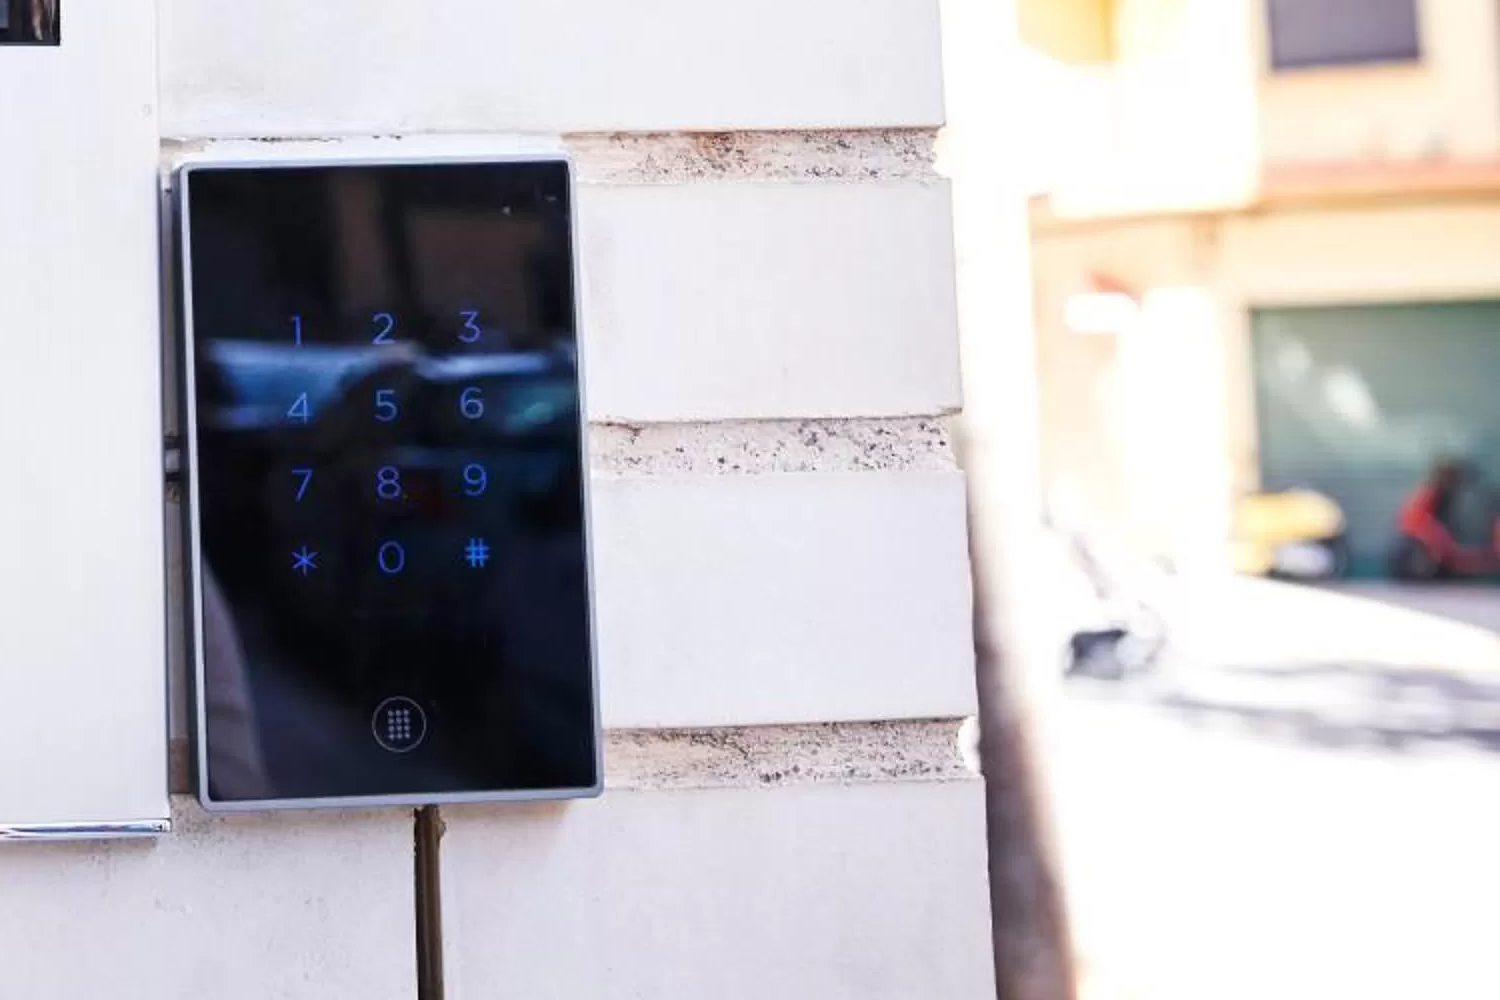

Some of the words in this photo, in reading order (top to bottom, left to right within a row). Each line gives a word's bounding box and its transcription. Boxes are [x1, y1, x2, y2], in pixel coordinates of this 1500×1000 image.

[289, 315, 303, 345] 1
[371, 314, 396, 344] 2
[458, 311, 482, 343] 3
[287, 392, 311, 424] 4
[374, 390, 399, 421] 5
[459, 388, 485, 419] 6
[290, 469, 314, 500] 7
[376, 467, 402, 498] 8
[462, 464, 488, 496] 9
[377, 542, 405, 574] 0
